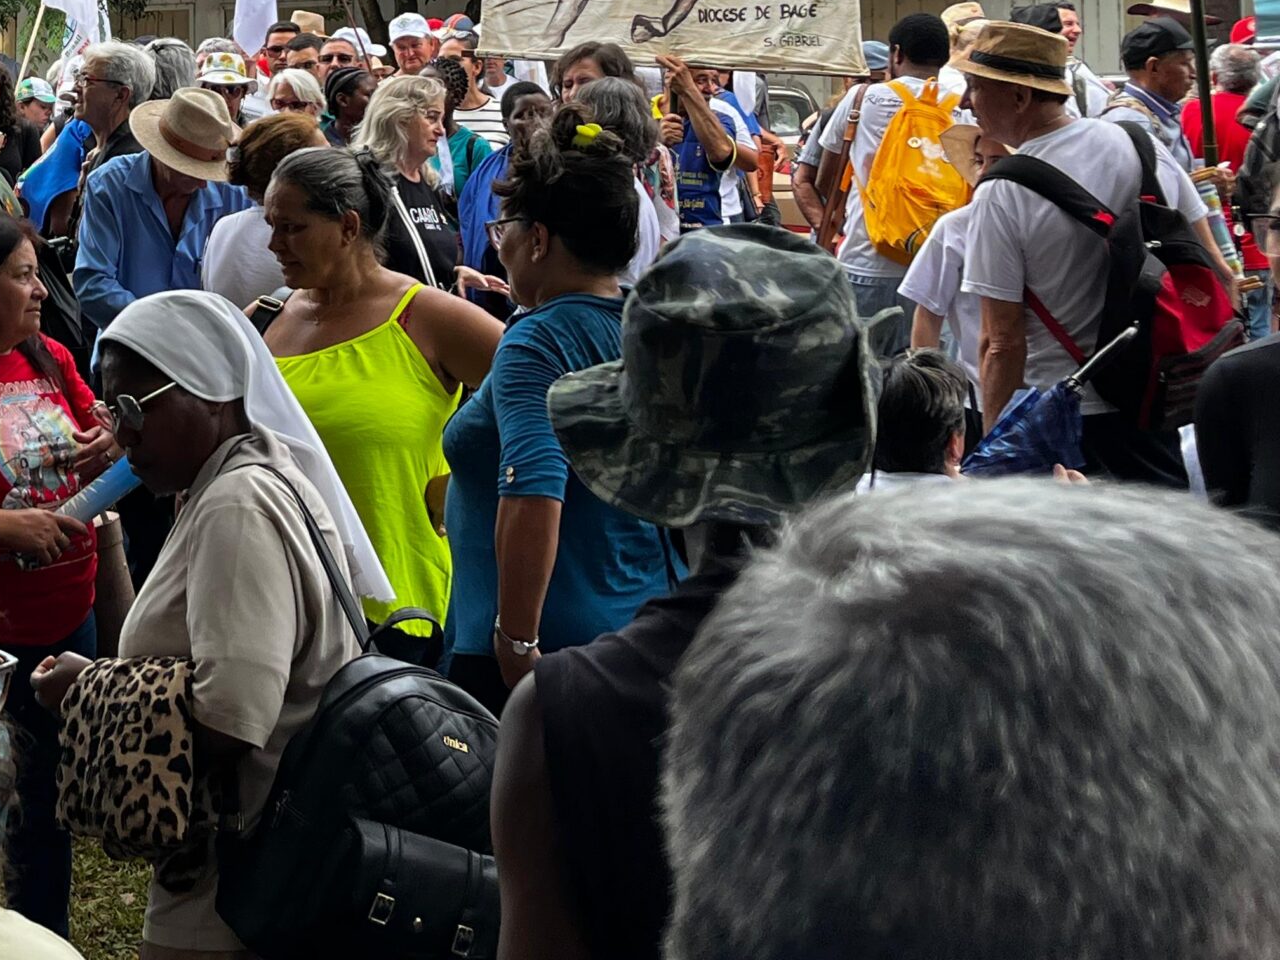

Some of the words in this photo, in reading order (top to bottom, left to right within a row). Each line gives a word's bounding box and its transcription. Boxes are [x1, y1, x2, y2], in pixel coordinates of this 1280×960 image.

[698, 7, 747, 23] DIOCESE
[754, 5, 771, 20] DE
[780, 35, 823, 48] GABRIEL
